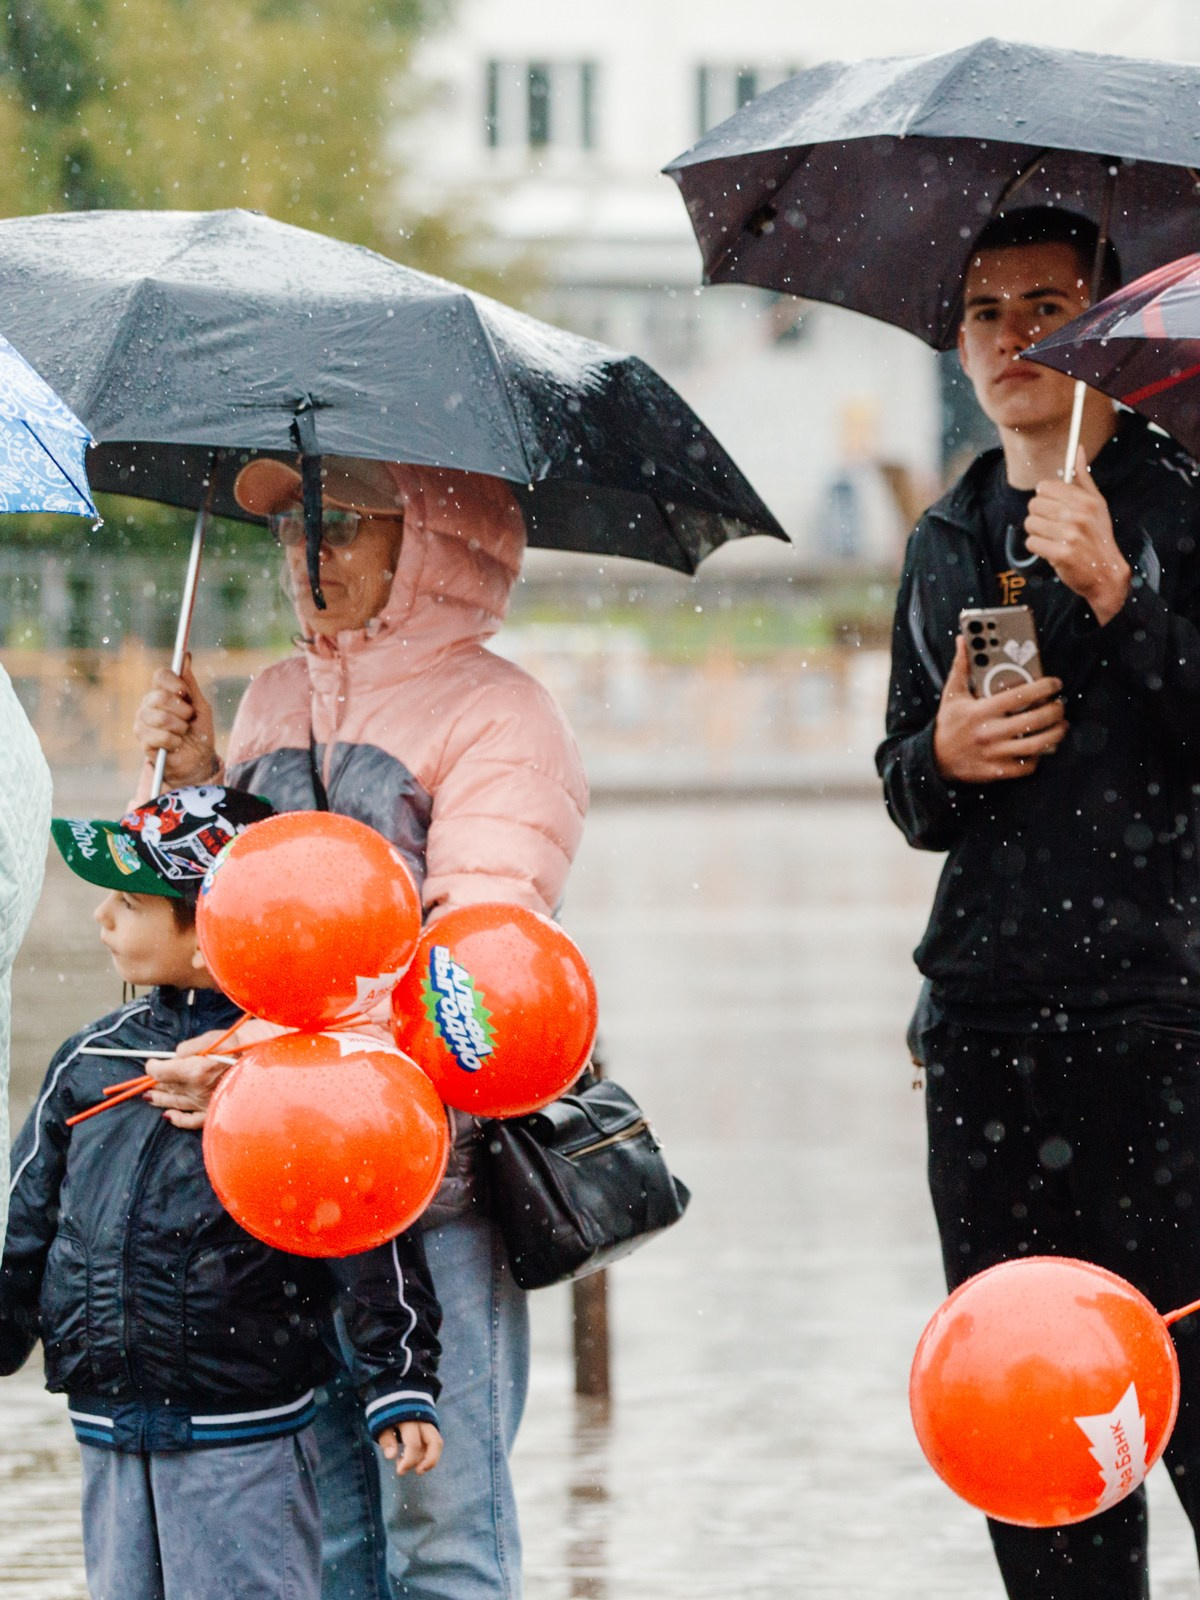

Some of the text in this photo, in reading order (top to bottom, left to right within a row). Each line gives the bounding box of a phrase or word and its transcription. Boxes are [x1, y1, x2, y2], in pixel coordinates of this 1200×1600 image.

[433, 945, 483, 1071] ВЫГОДНО
[450, 961, 494, 1057] АЛЬФА
[1109, 1418, 1132, 1470] Банк
